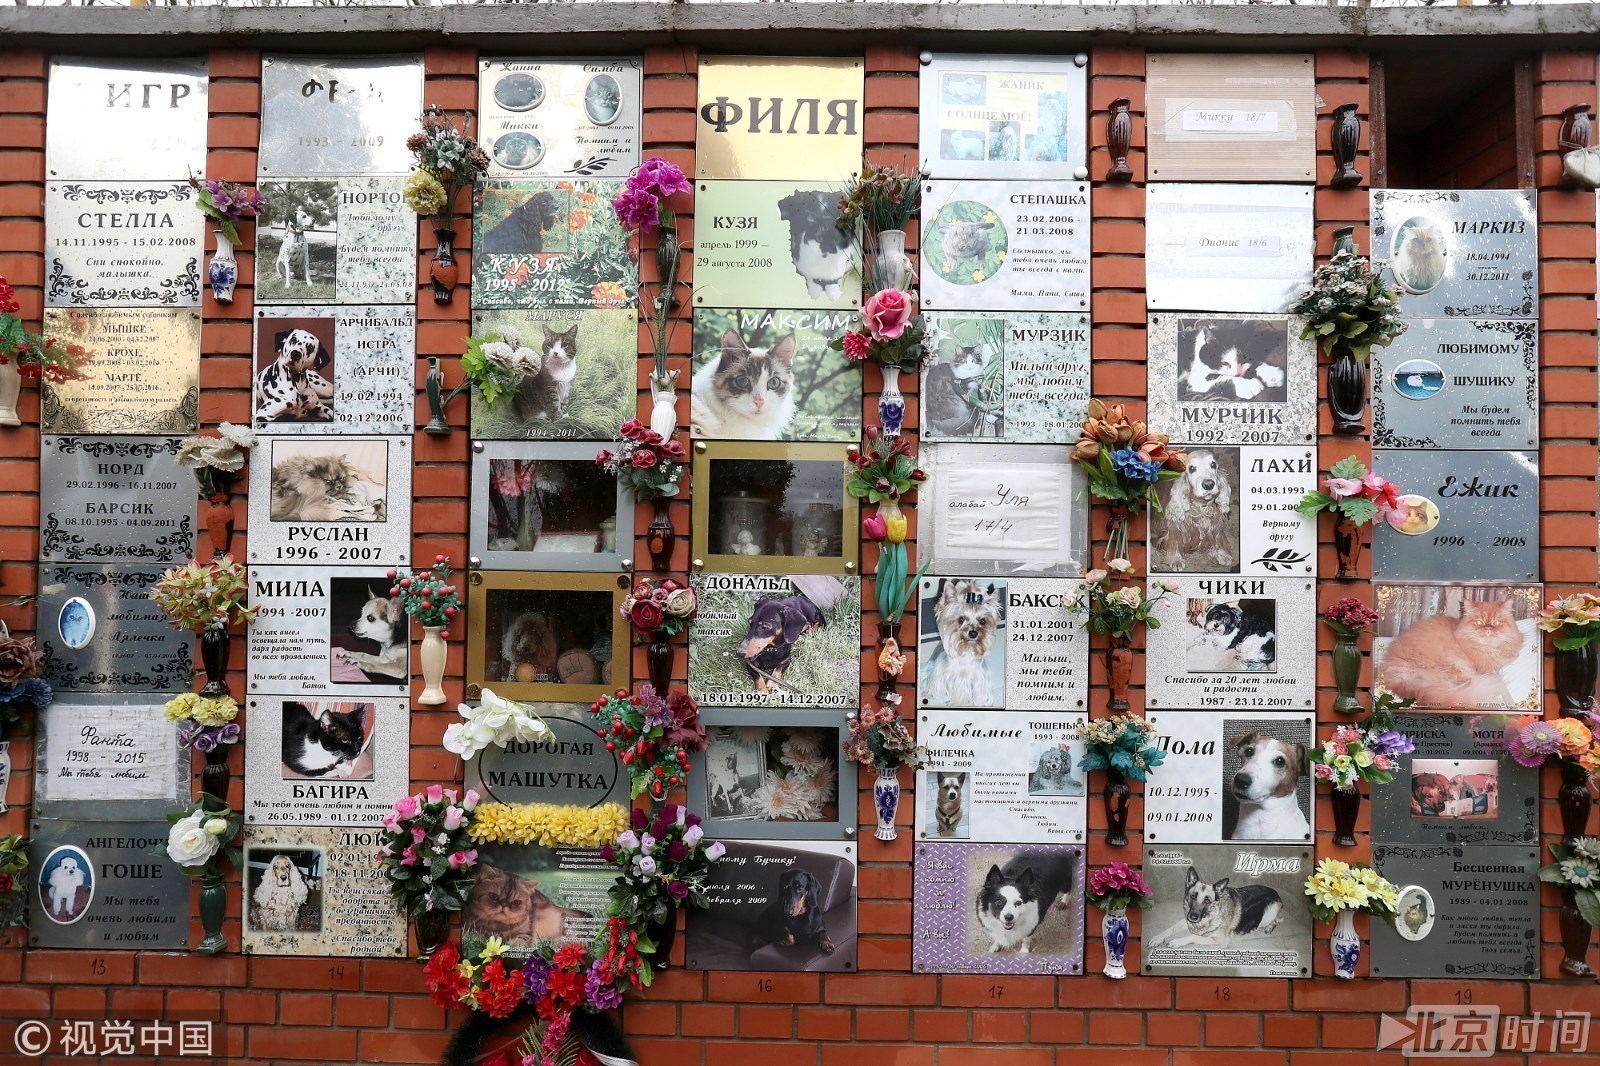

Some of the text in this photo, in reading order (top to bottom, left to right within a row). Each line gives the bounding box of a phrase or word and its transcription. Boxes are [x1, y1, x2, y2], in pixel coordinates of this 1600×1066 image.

[500, 62, 624, 73] Жанна Симба
[999, 79, 1045, 91] ЖАНИК
[700, 96, 858, 136] ФИЛЯ
[947, 109, 998, 121] СОЛНЦЕ
[1195, 111, 1266, 124] Микки 18/7
[499, 120, 539, 130] Микки
[1010, 194, 1087, 205] СТЕПАШКА
[77, 212, 174, 228] СТЕЛЛА
[713, 216, 758, 230] КУЗЯ
[1016, 215, 1074, 223] 23.02.2006
[1016, 227, 1074, 236] 21.03.2008
[1451, 221, 1526, 234] МАРКИЗ
[55, 237, 196, 247] 14.11.1995 15.02.2008
[700, 239, 758, 250] апрель 1999
[1199, 237, 1267, 249] Дионис 18/6
[1466, 252, 1510, 261] 18.04.1994
[490, 256, 560, 275] КУЗЯ
[696, 257, 773, 270] 29 августа 2008
[1465, 272, 1510, 281] 30.12.2011
[484, 278, 566, 292] 1995 2012
[525, 310, 584, 322] МАРУСЯ
[740, 312, 851, 331] МАКСИМ
[339, 318, 413, 327] АРЧИБАЛЬД
[1012, 329, 1087, 342] МУРЗИК
[357, 340, 397, 349] ИСТРА
[1437, 343, 1520, 354] ЛЮБИМОМУ
[1008, 360, 1053, 372] Милый
[353, 367, 401, 378] (АРЧИ)
[1453, 376, 1516, 387] ШУШИКУ
[340, 392, 403, 401] 19.02.1994
[1008, 388, 1040, 401] тебя
[1181, 407, 1283, 425] МУРЧИК
[1461, 405, 1510, 416] Мы будем
[339, 414, 403, 423] 02.12.2006
[1450, 418, 1521, 426] помнить тебя
[1186, 430, 1280, 443] 1992 2007
[1470, 429, 1501, 437] всегда
[97, 463, 145, 476] НОРД
[1250, 458, 1312, 473] ЛАХИ
[66, 480, 177, 490] 29.02.1996 16.11.2007
[1251, 486, 1305, 495] 04.03.1993
[1437, 475, 1520, 498] Ежик
[85, 502, 154, 515] БАРСИК
[65, 518, 176, 527] 08.10.1995 04.09.2011
[1262, 519, 1301, 530] Верному
[287, 526, 369, 542] РУСЛАН
[1269, 532, 1294, 542] другу
[1432, 536, 1527, 547] 1996 2008
[276, 547, 382, 560] 1996 2007
[255, 580, 326, 597] МИЛА
[706, 577, 791, 591] ДОНАЛЬД
[1198, 580, 1266, 595] ЧИКИ
[106, 609, 168, 622] любимая
[1012, 620, 1074, 629] 31.01.2001
[697, 628, 732, 636] таксик
[1012, 633, 1074, 642] 24.12.2007
[1021, 653, 1072, 665] Малыш,
[1019, 667, 1073, 676] мы тебя
[1016, 680, 1065, 689] помним
[1164, 675, 1209, 685] Спасибо
[1224, 676, 1237, 684] 20
[1262, 676, 1297, 686] любви
[1212, 685, 1258, 695] радости
[702, 693, 847, 705] 18.01.1997 14.12.2007
[1199, 697, 1293, 706] 1987 23.12.2007
[80, 725, 137, 748] Фанта
[930, 722, 1023, 739] Любимые
[1472, 730, 1505, 739] МОТЯ
[503, 740, 594, 756] ДОРОГАЯ
[65, 750, 147, 764] 1998 2015
[488, 771, 609, 790] МАШУТКА
[292, 785, 369, 800] БАГИРА
[1148, 787, 1211, 798] 10.12.1995
[252, 800, 269, 808] Мы
[294, 801, 320, 809] очень
[322, 801, 353, 810] любим
[267, 812, 385, 822] 26.05.1989 01.12.2007
[1147, 812, 1213, 823] 09.01.2008
[1234, 852, 1300, 877] Ирма
[1453, 861, 1525, 874] Бесценная
[101, 863, 164, 879] ГОШЕ
[1442, 879, 1536, 892] МУРЁНУШКА
[103, 895, 161, 906] Мы тебя
[87, 913, 177, 925] очень любили
[115, 930, 160, 942] любим
[91, 958, 107, 976] 13
[327, 965, 345, 980] 14
[757, 978, 773, 993] 16
[988, 984, 1006, 1000] 17
[1214, 985, 1231, 1001] 18
[1454, 988, 1473, 1005] 19
